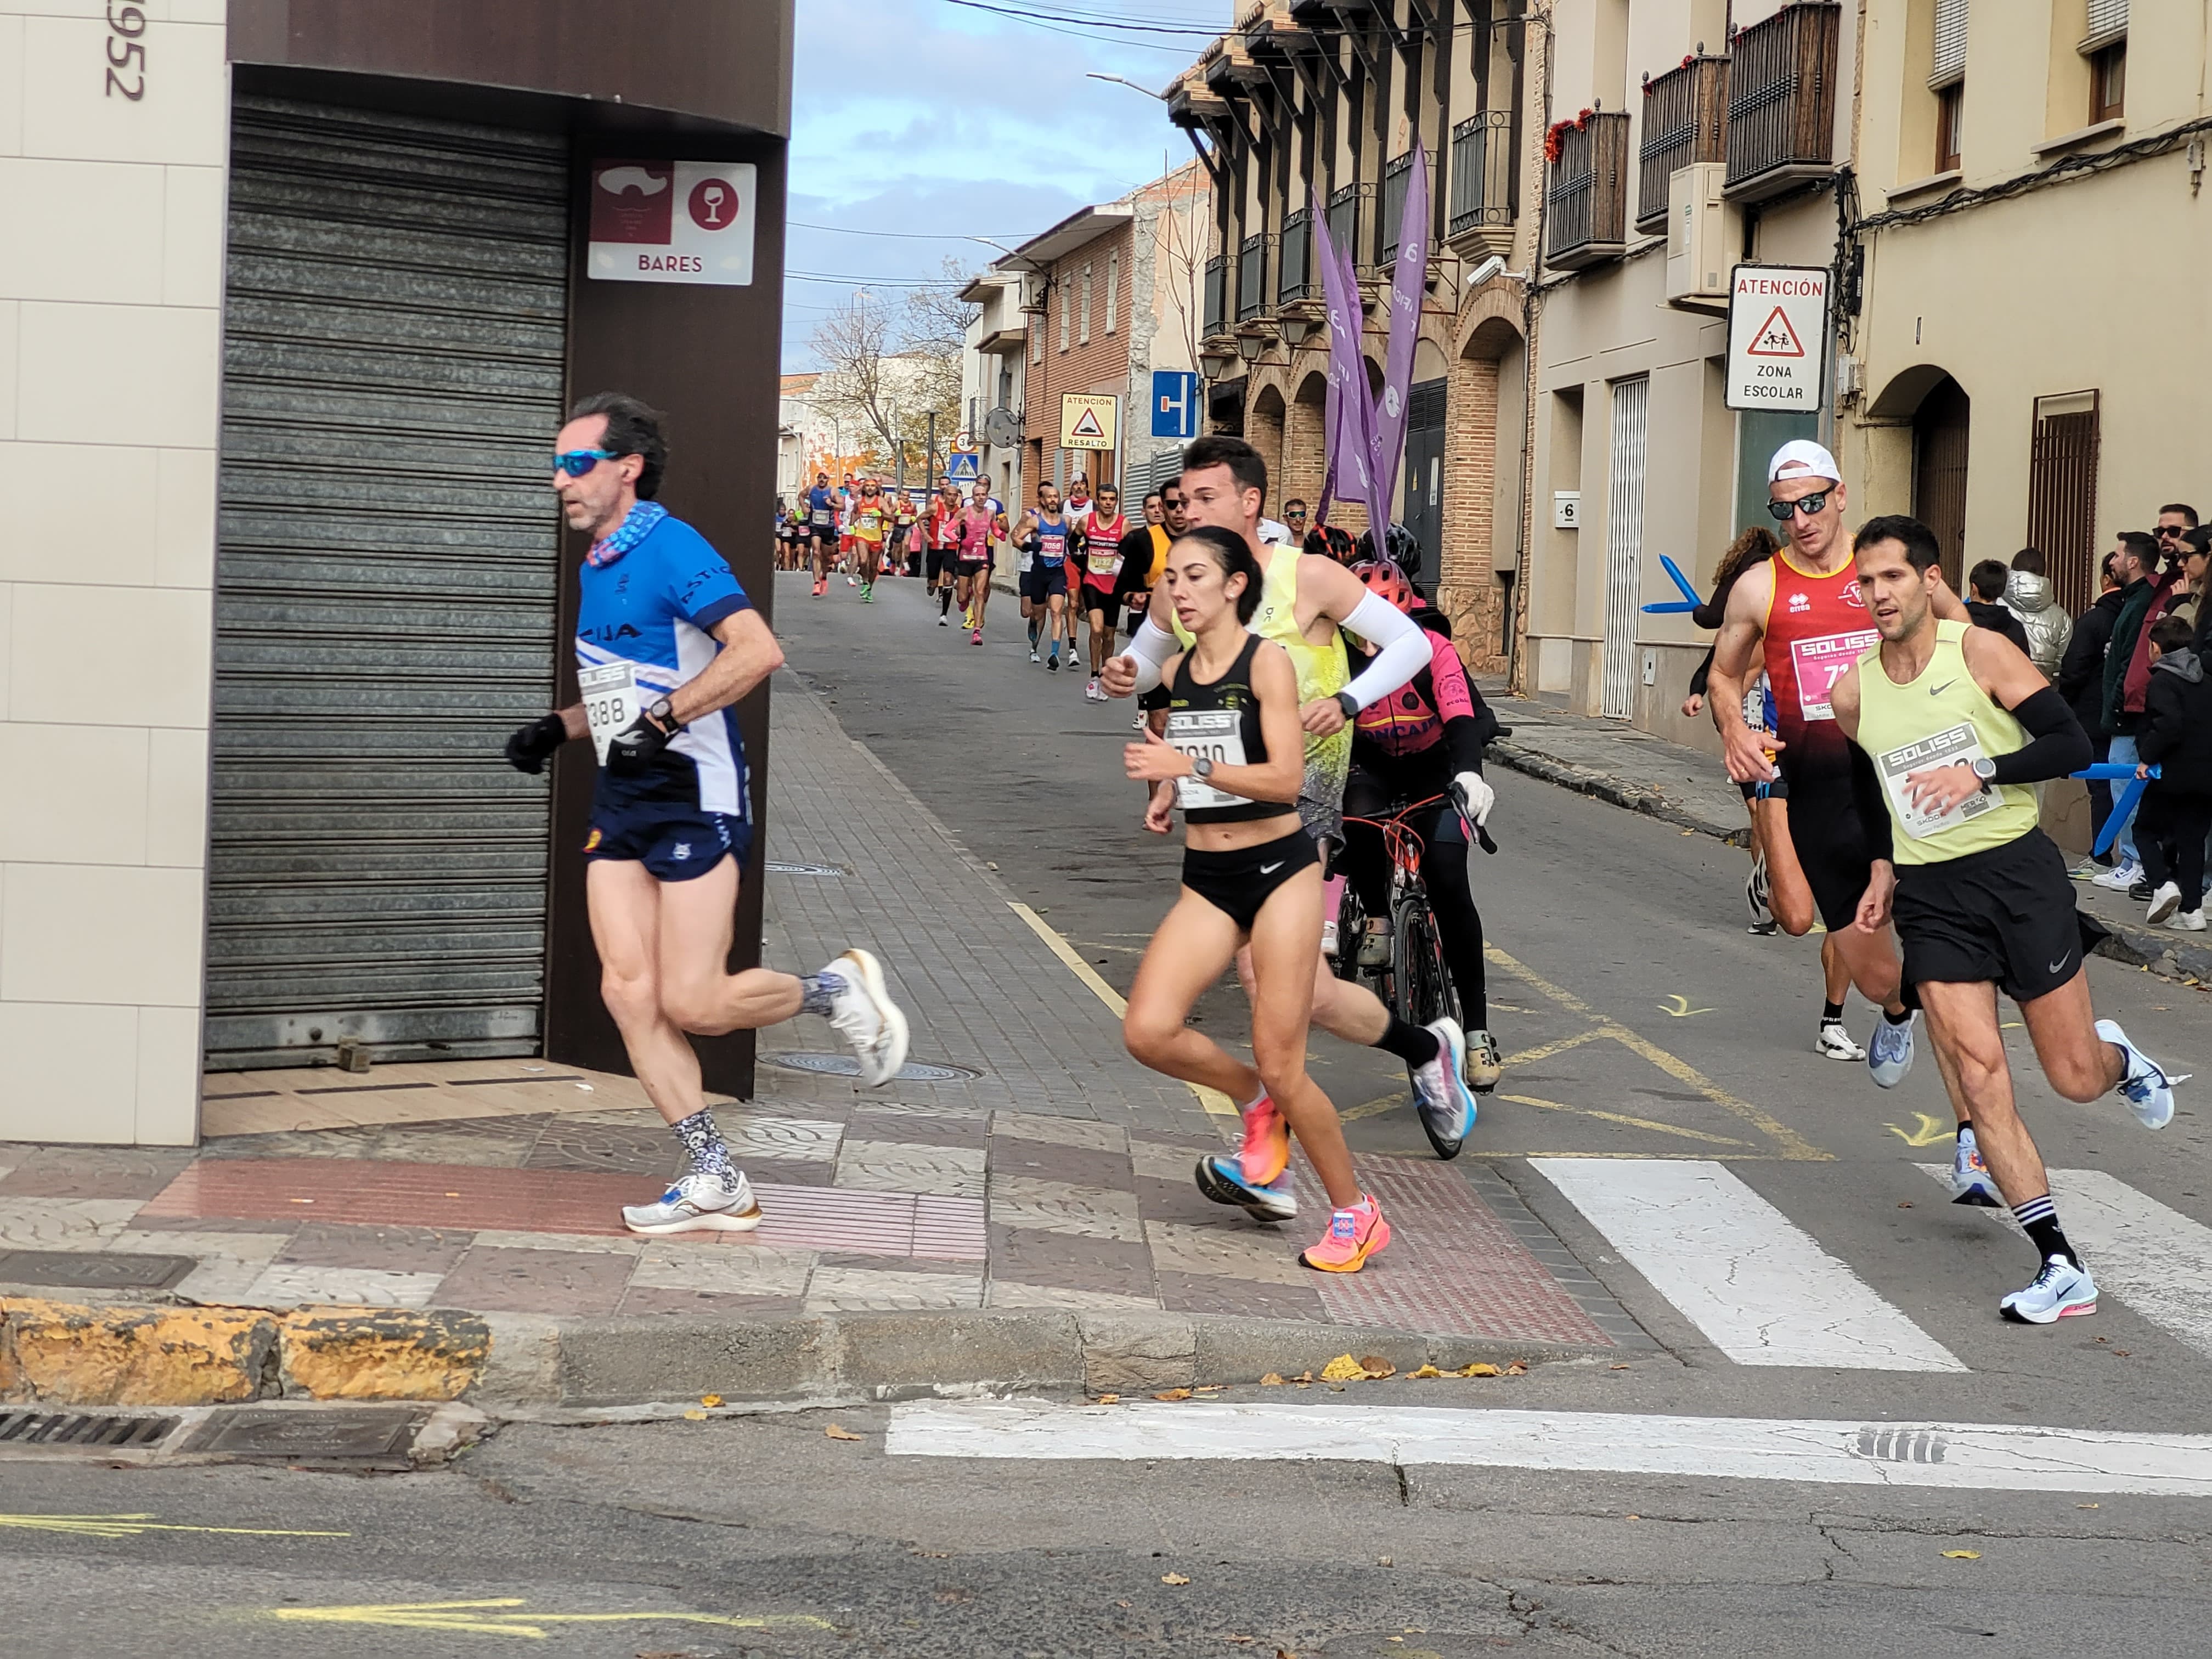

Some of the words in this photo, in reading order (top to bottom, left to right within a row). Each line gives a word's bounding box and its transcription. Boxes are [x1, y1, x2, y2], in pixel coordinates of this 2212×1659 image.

[106, 0, 145, 101] 952
[638, 254, 702, 273] BARES
[1737, 278, 1823, 297] ATENCIÓN
[1757, 365, 1792, 378] ZONA
[1743, 385, 1803, 399] ESCOLAR
[1066, 397, 1112, 406] ATENCION
[1068, 438, 1108, 448] RESALTO
[1565, 503, 1574, 517] 6
[1801, 634, 1879, 657] SOLISS
[1169, 714, 1232, 731] SOLISS
[1888, 727, 1967, 768] SOLISS
